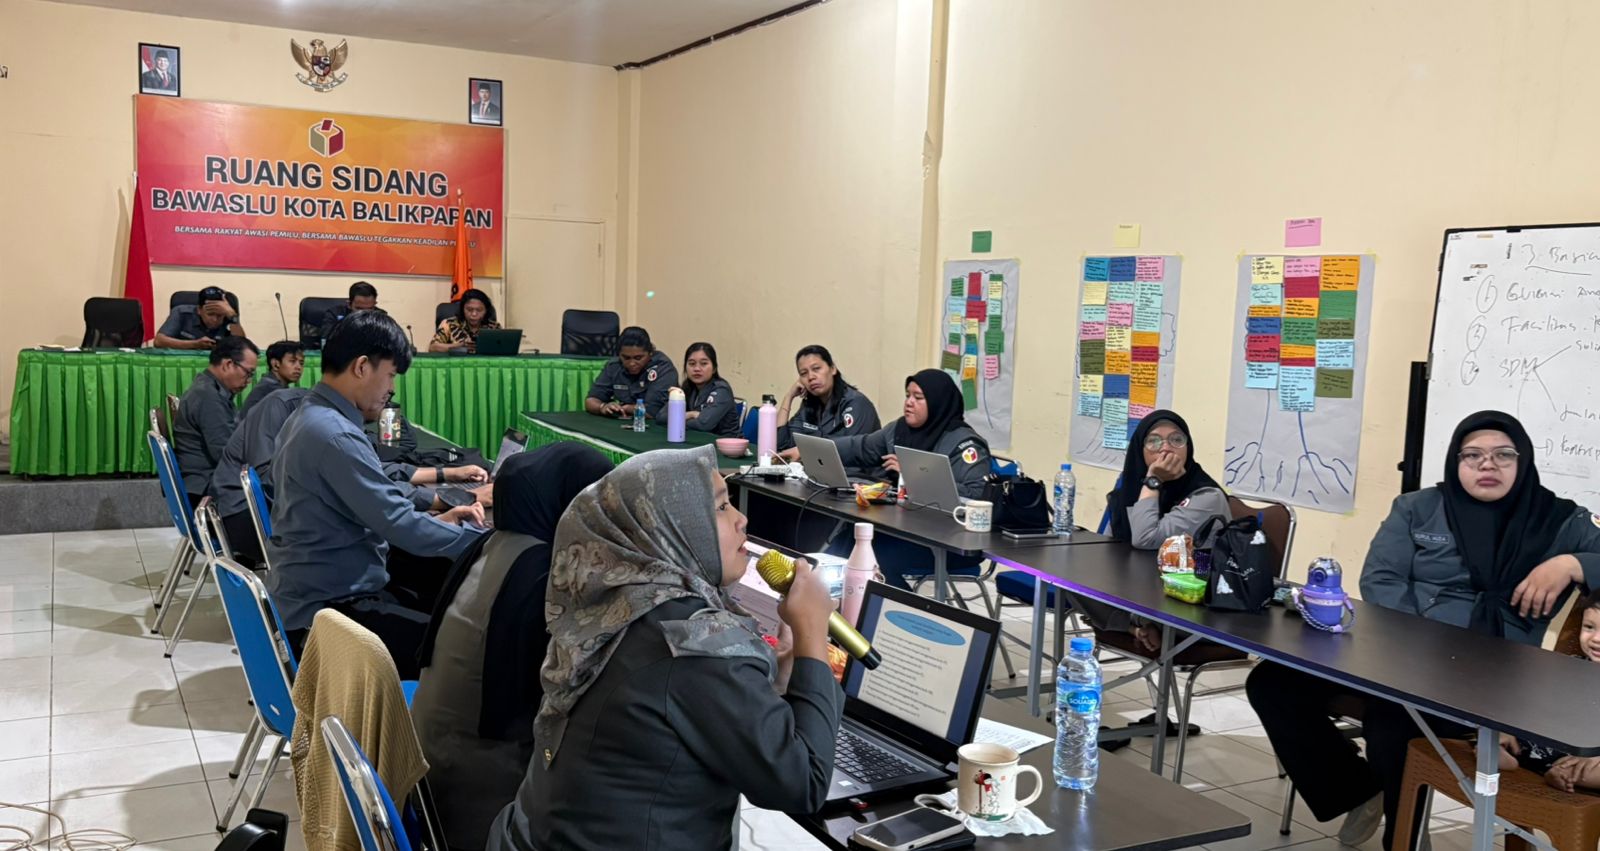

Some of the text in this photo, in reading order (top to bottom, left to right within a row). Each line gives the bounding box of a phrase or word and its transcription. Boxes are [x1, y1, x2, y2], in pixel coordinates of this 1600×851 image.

[205, 156, 448, 198] RUANG SIDANG
[152, 188, 492, 229] BAWASLU KOTA BALIKPAPAN
[174, 225, 212, 234] BERSAMA
[214, 227, 243, 236] RAKYAT
[245, 229, 268, 237] AWASI
[302, 232, 337, 241] BERSAMA
[338, 234, 373, 242] BAWASLU
[373, 236, 412, 244] TEGAKKAN
[413, 238, 449, 247] KEADILAN
[1499, 357, 1538, 378] SDM
